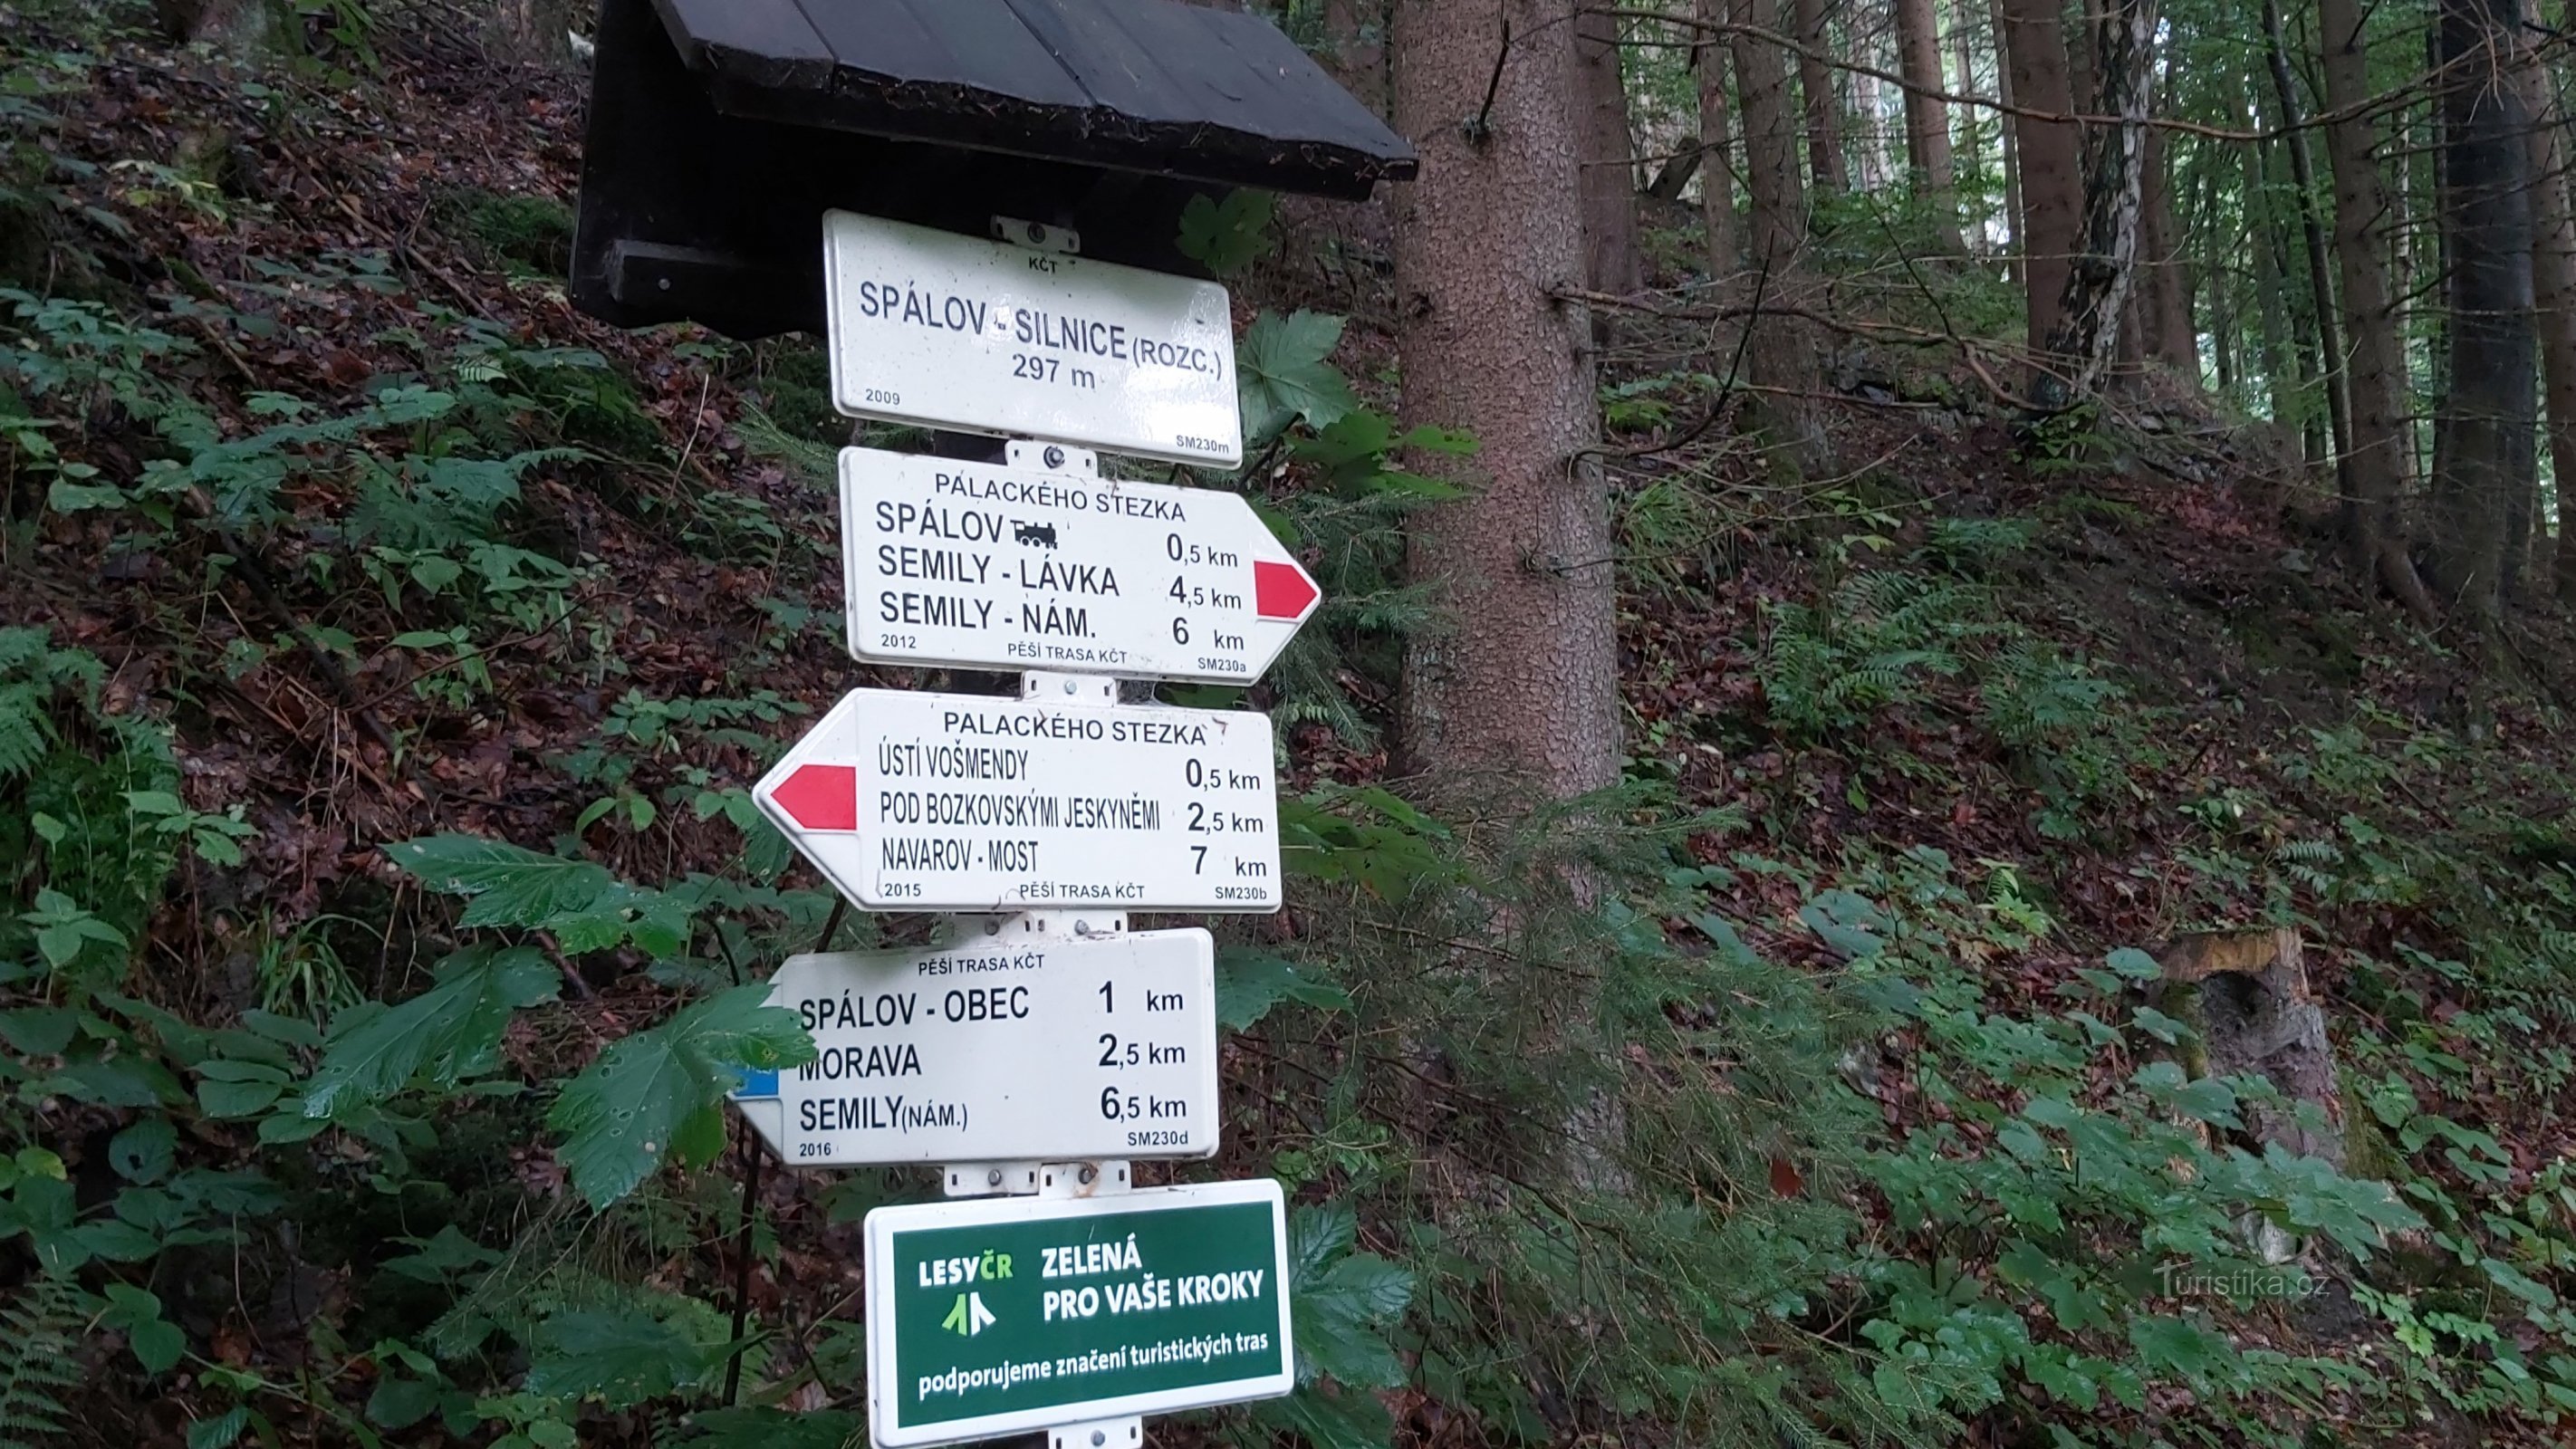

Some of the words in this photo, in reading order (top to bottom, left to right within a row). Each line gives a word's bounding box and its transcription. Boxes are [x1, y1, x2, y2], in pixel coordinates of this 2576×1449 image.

[1028, 256, 1058, 274] KČT
[860, 281, 986, 335] SPÁLOV
[1015, 309, 1127, 360] SILNICE
[1013, 354, 1060, 382] 297
[1072, 368, 1095, 389] m
[866, 389, 900, 406] 2009
[1176, 435, 1230, 454] SM230m
[1096, 494, 1186, 523] STEZKA
[876, 500, 1004, 543] SPÁLOV
[1167, 533, 1200, 565] 0,5
[1208, 545, 1238, 568] km
[879, 545, 991, 585] SEMILY
[1020, 554, 1120, 596] LÁVKA
[1168, 575, 1204, 607] 4,5
[1211, 587, 1243, 609] km
[880, 591, 993, 630] SEMILY
[1023, 598, 1096, 638] NÁM.
[1173, 617, 1189, 645] 6
[1215, 629, 1245, 650] km
[881, 633, 917, 649] 2012
[1008, 641, 1041, 657] PĚŠÍ
[1045, 646, 1095, 661] TRASA
[1099, 648, 1127, 664] KČT
[1197, 657, 1246, 673] SM230a
[944, 711, 1103, 741] PALACKÉHO
[1112, 721, 1206, 745] STEZKA
[879, 735, 921, 777] ÚSTÍ
[926, 739, 1028, 781] VOŠMENDY
[1185, 758, 1221, 791] 0,5
[1228, 769, 1261, 790] km
[880, 792, 923, 824] POD
[926, 786, 1059, 828] BOZKOVSKÝMI
[1064, 792, 1160, 830] JESKYNĚMI
[1187, 802, 1224, 835] 2,5
[1232, 812, 1264, 833] km
[881, 838, 972, 871] NAVAROV
[988, 840, 1038, 872] MOST
[1190, 845, 1207, 875] 7
[1235, 856, 1267, 877] km
[884, 882, 921, 897] 2015
[1019, 879, 1055, 898] PĚŠÍ
[1059, 884, 1110, 898] TRASA
[1114, 880, 1145, 898] KČT
[1215, 886, 1267, 900] SM230b
[918, 957, 953, 976] PĚŠÍ
[956, 957, 1009, 974] TRASA
[1014, 954, 1044, 971] KČT
[800, 988, 917, 1031] SPÁLOV
[944, 986, 1030, 1022] OBEC
[1099, 981, 1114, 1013] 1
[1147, 990, 1184, 1012] km
[1098, 1033, 1140, 1070] 2,5
[1149, 1042, 1186, 1064] km
[1101, 1087, 1141, 1123] 6,5
[1149, 1096, 1187, 1118] km
[799, 1143, 831, 1157] 2016
[1127, 1130, 1189, 1147] SM230d
[1041, 1233, 1142, 1279] ZELENÁ
[1043, 1290, 1100, 1321] PRO
[1105, 1272, 1171, 1314] VAŠE
[1177, 1269, 1264, 1306] KROKY
[918, 1358, 1052, 1401] podporujeme
[1056, 1345, 1127, 1377] značení
[1129, 1333, 1232, 1367] turistických
[1235, 1331, 1268, 1355] tras
